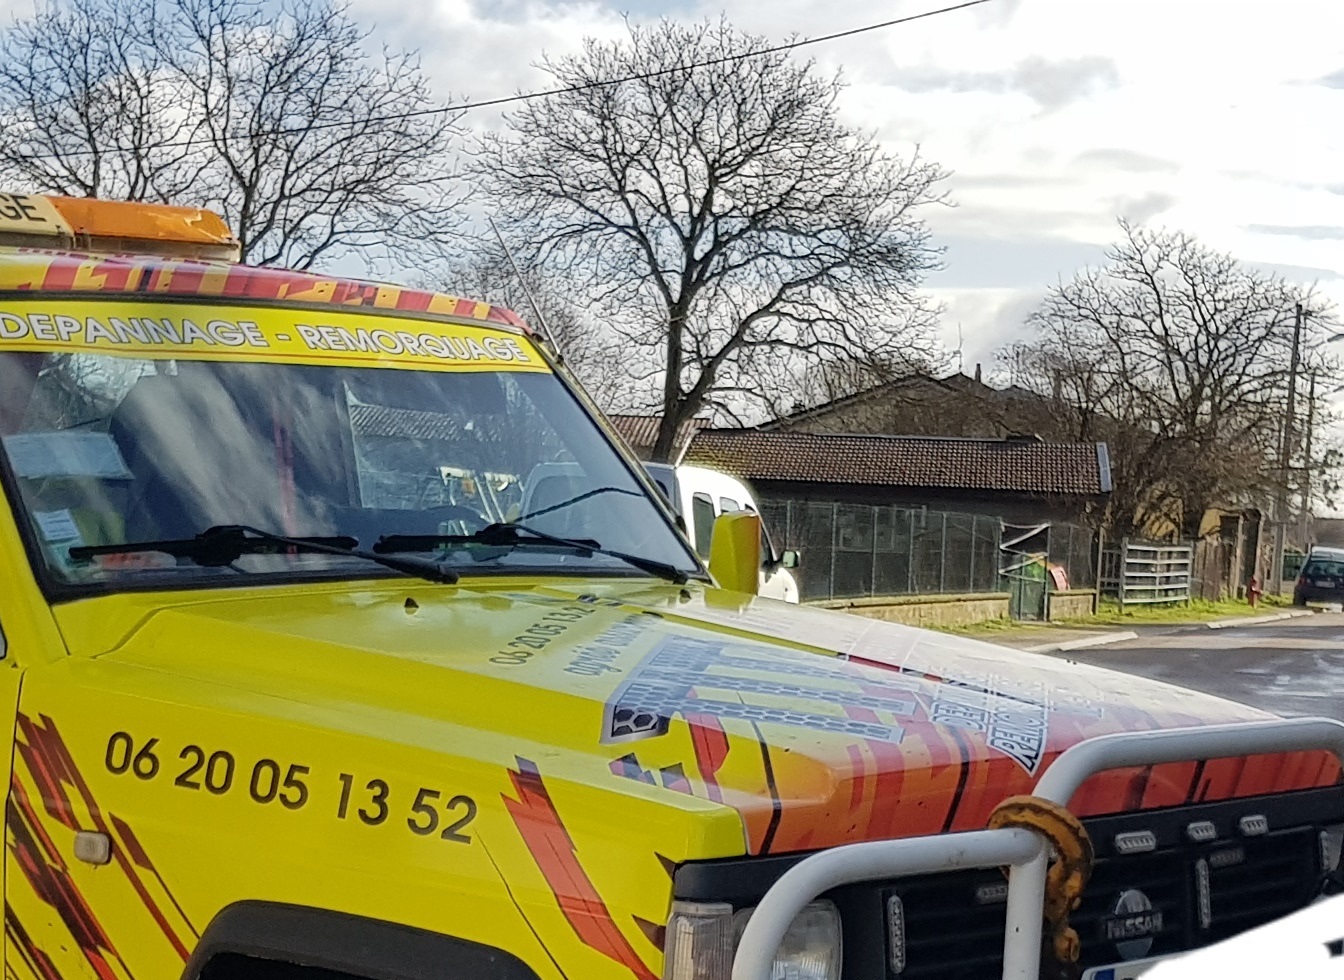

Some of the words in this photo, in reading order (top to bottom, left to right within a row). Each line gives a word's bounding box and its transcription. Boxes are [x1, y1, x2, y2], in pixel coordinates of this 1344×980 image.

[299, 324, 531, 363] REMORQUAGE
[104, 731, 160, 781] 06
[174, 744, 236, 796] 20
[249, 757, 312, 810] 05
[336, 772, 391, 827] 13
[406, 786, 479, 845] 52
